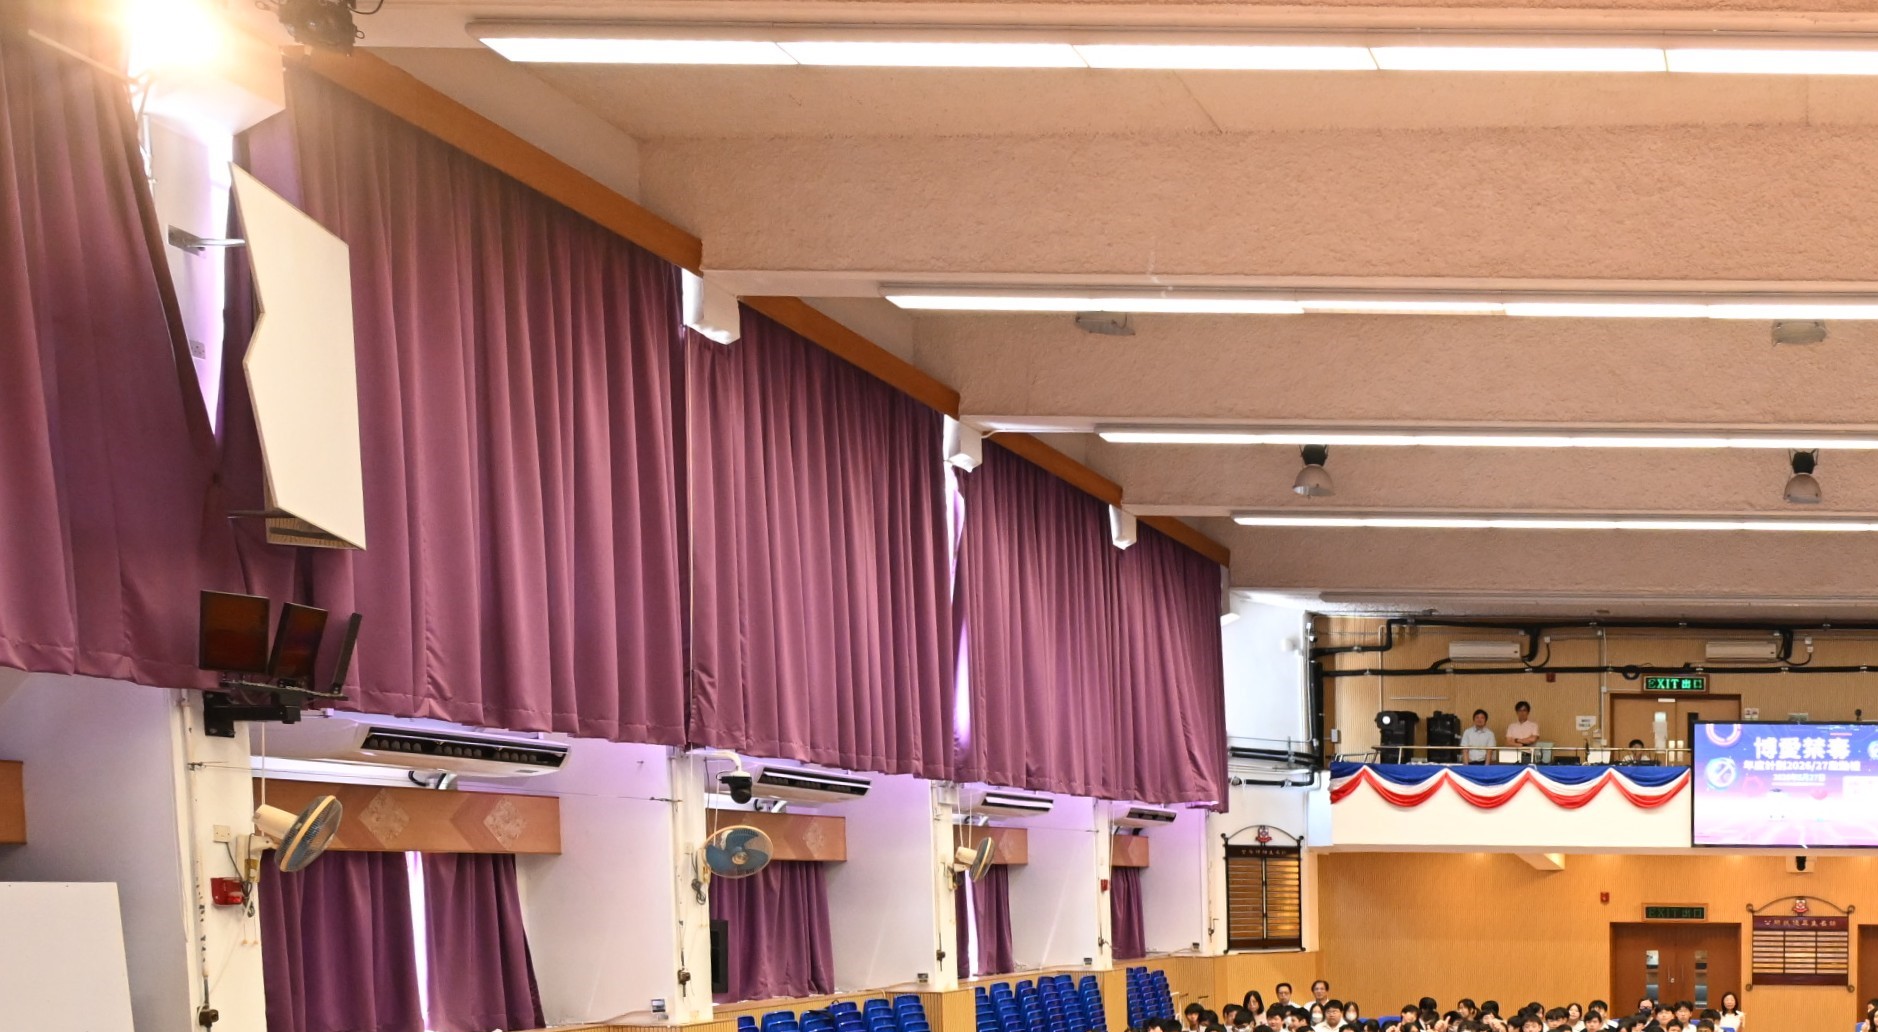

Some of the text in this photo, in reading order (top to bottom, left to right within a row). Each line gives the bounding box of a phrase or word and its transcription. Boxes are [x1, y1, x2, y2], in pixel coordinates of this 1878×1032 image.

[1648, 679, 1702, 689] EXIT 出口
[1754, 736, 1850, 759] 博愛禁毒
